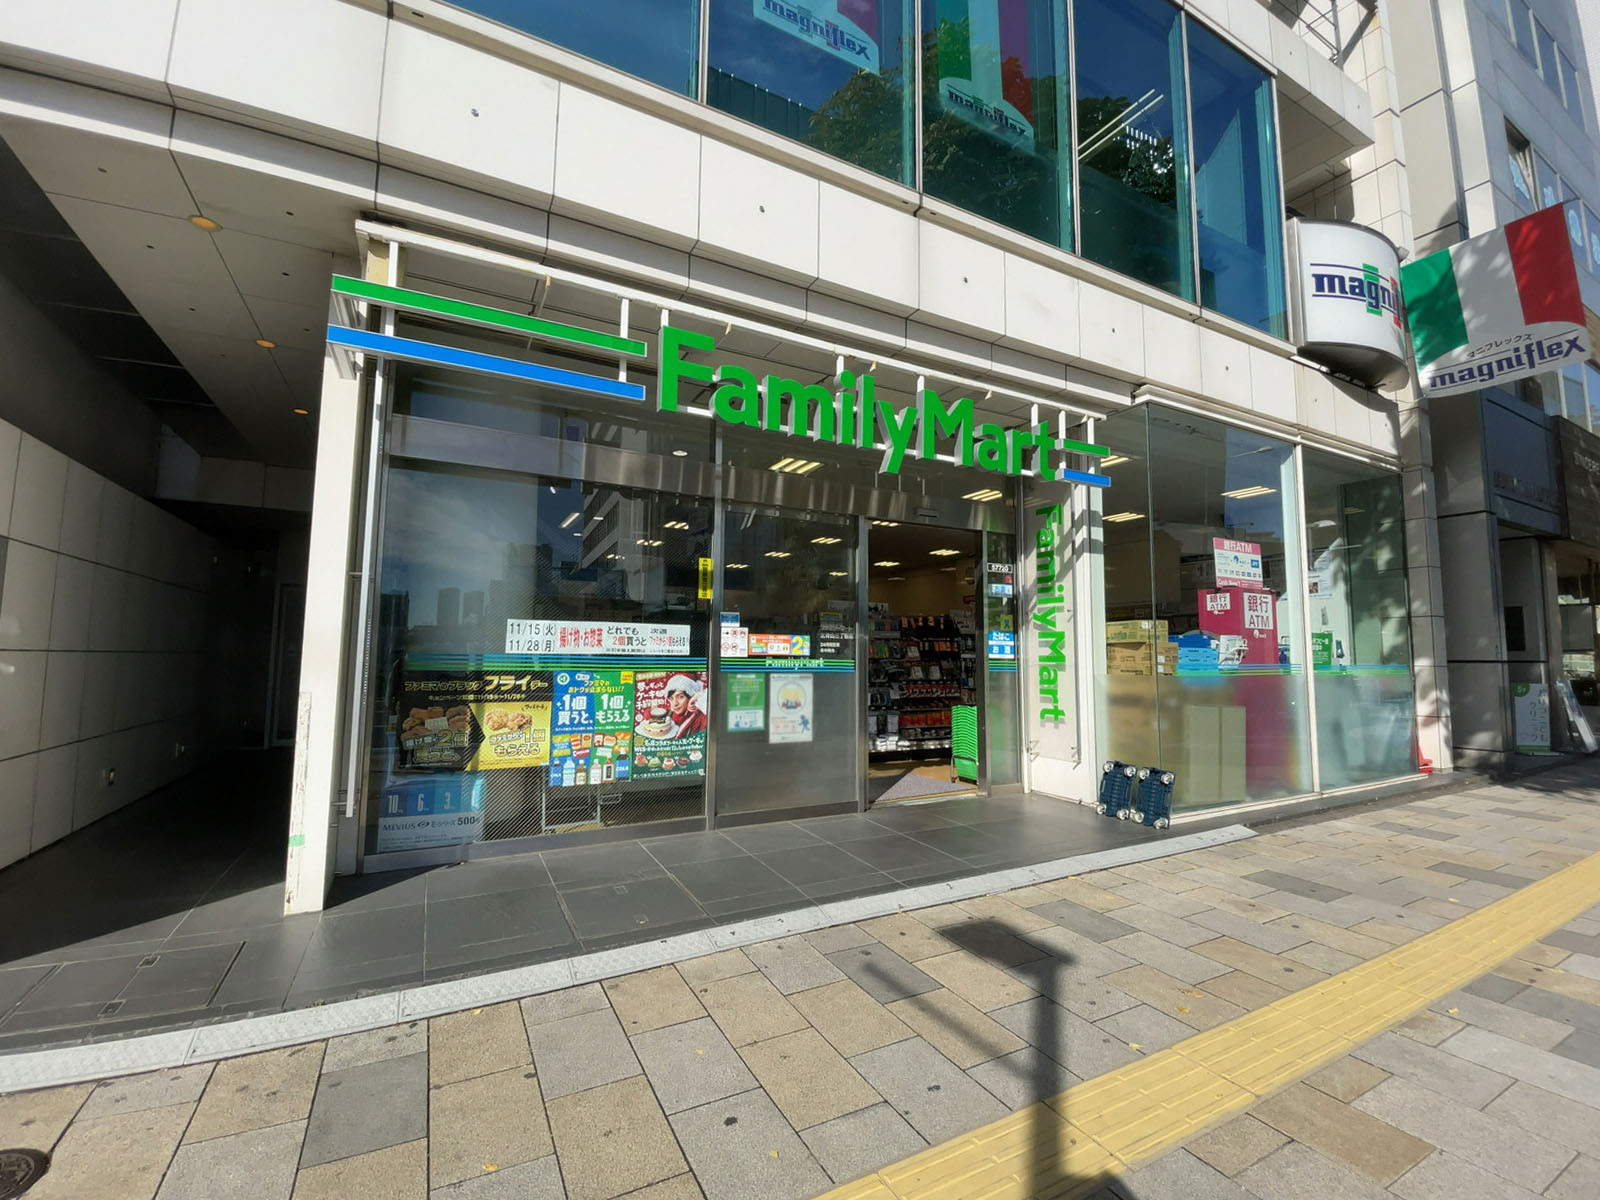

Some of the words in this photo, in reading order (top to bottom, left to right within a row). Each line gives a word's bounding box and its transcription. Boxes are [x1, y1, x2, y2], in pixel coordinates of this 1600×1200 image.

[1466, 333, 1534, 358] マニフレックス
[1429, 336, 1586, 390] magniflex
[657, 325, 1057, 482] FamilyMart
[1223, 540, 1253, 553] 銀行ATM
[1209, 593, 1227, 603] 銀行
[1247, 594, 1269, 613] 銀行
[1032, 503, 1067, 724] FamilyMart
[1248, 615, 1270, 628] ATM
[606, 625, 640, 635] どれでも
[612, 636, 648, 646] 2個買うと
[765, 657, 824, 671] FamilyMart
[595, 709, 630, 724] もらえる
[388, 794, 399, 814] 10
[417, 793, 425, 812] 6
[443, 791, 452, 810] 3
[383, 822, 416, 832] MEVIUS
